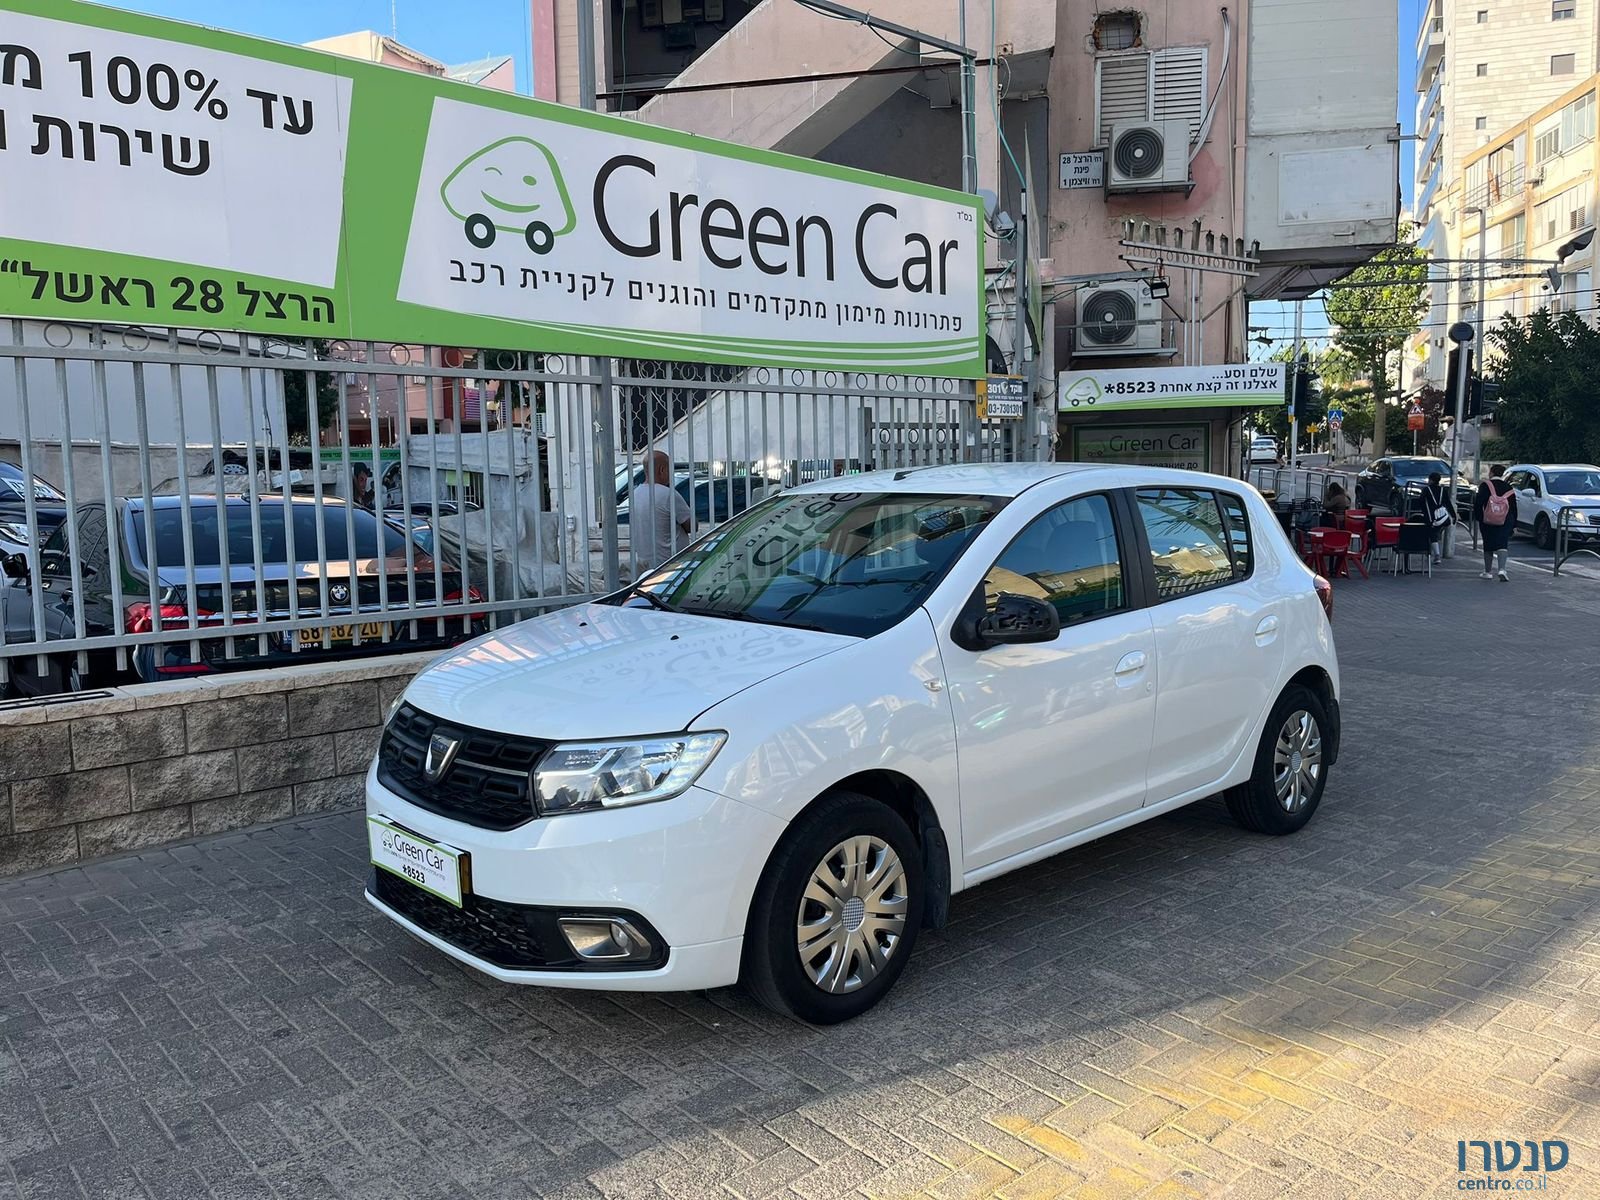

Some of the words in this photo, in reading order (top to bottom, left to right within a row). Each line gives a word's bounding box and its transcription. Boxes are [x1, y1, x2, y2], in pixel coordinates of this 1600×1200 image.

[68, 51, 228, 120] 100%
[246, 88, 313, 135] עד
[31, 114, 210, 176] שירות
[1062, 156, 1071, 164] 28
[1073, 155, 1092, 163] הרצל
[1073, 166, 1090, 174] פינת
[1063, 178, 1067, 186] 1
[593, 155, 835, 281] Green
[855, 203, 959, 295] Car
[450, 259, 505, 286] רכב
[170, 276, 224, 313] 28
[520, 268, 615, 300] לקניית
[629, 280, 716, 307] והוגנים
[237, 281, 335, 323] הרצל
[728, 291, 827, 321] מתקדמים
[836, 303, 885, 325] מימון
[893, 310, 962, 332] פתרונות
[1212, 369, 1245, 379] וסע...
[1250, 367, 1277, 377] שלם
[987, 384, 1001, 393] 301
[1160, 382, 1192, 392] אחרת
[1196, 381, 1221, 393] קצת
[1226, 381, 1239, 390] זה
[1243, 379, 1277, 389] אצלנו
[1110, 435, 1163, 451] Green
[1168, 433, 1199, 450] Car
[393, 834, 424, 862] Green
[426, 848, 444, 871] Car
